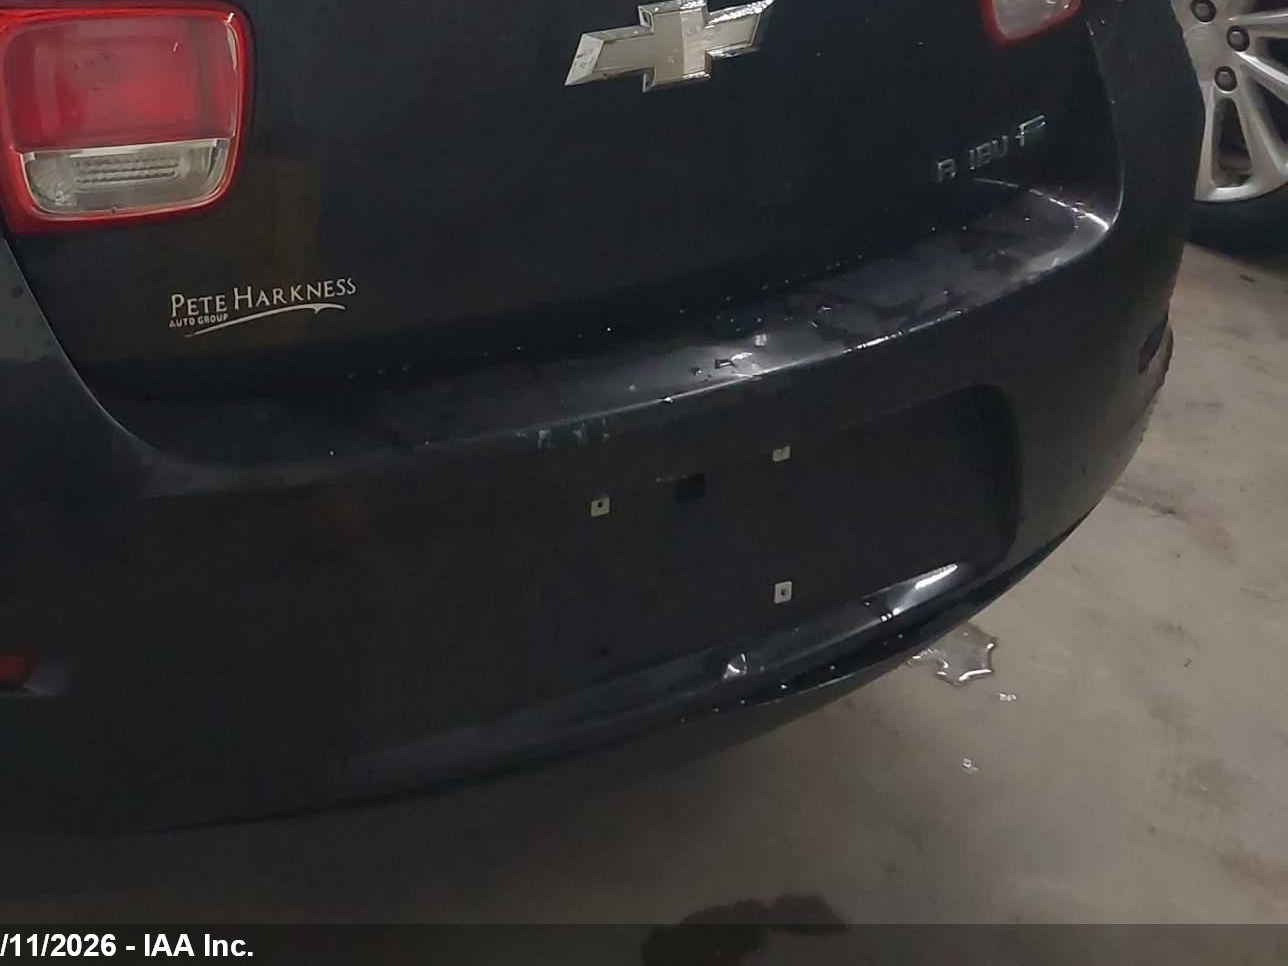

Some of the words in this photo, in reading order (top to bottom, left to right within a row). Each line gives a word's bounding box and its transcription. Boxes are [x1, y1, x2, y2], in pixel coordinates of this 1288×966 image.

[170, 293, 228, 317] PETE
[232, 277, 357, 311] HARKNESS
[169, 316, 195, 328] AUTO
[197, 312, 229, 324] GROUP
